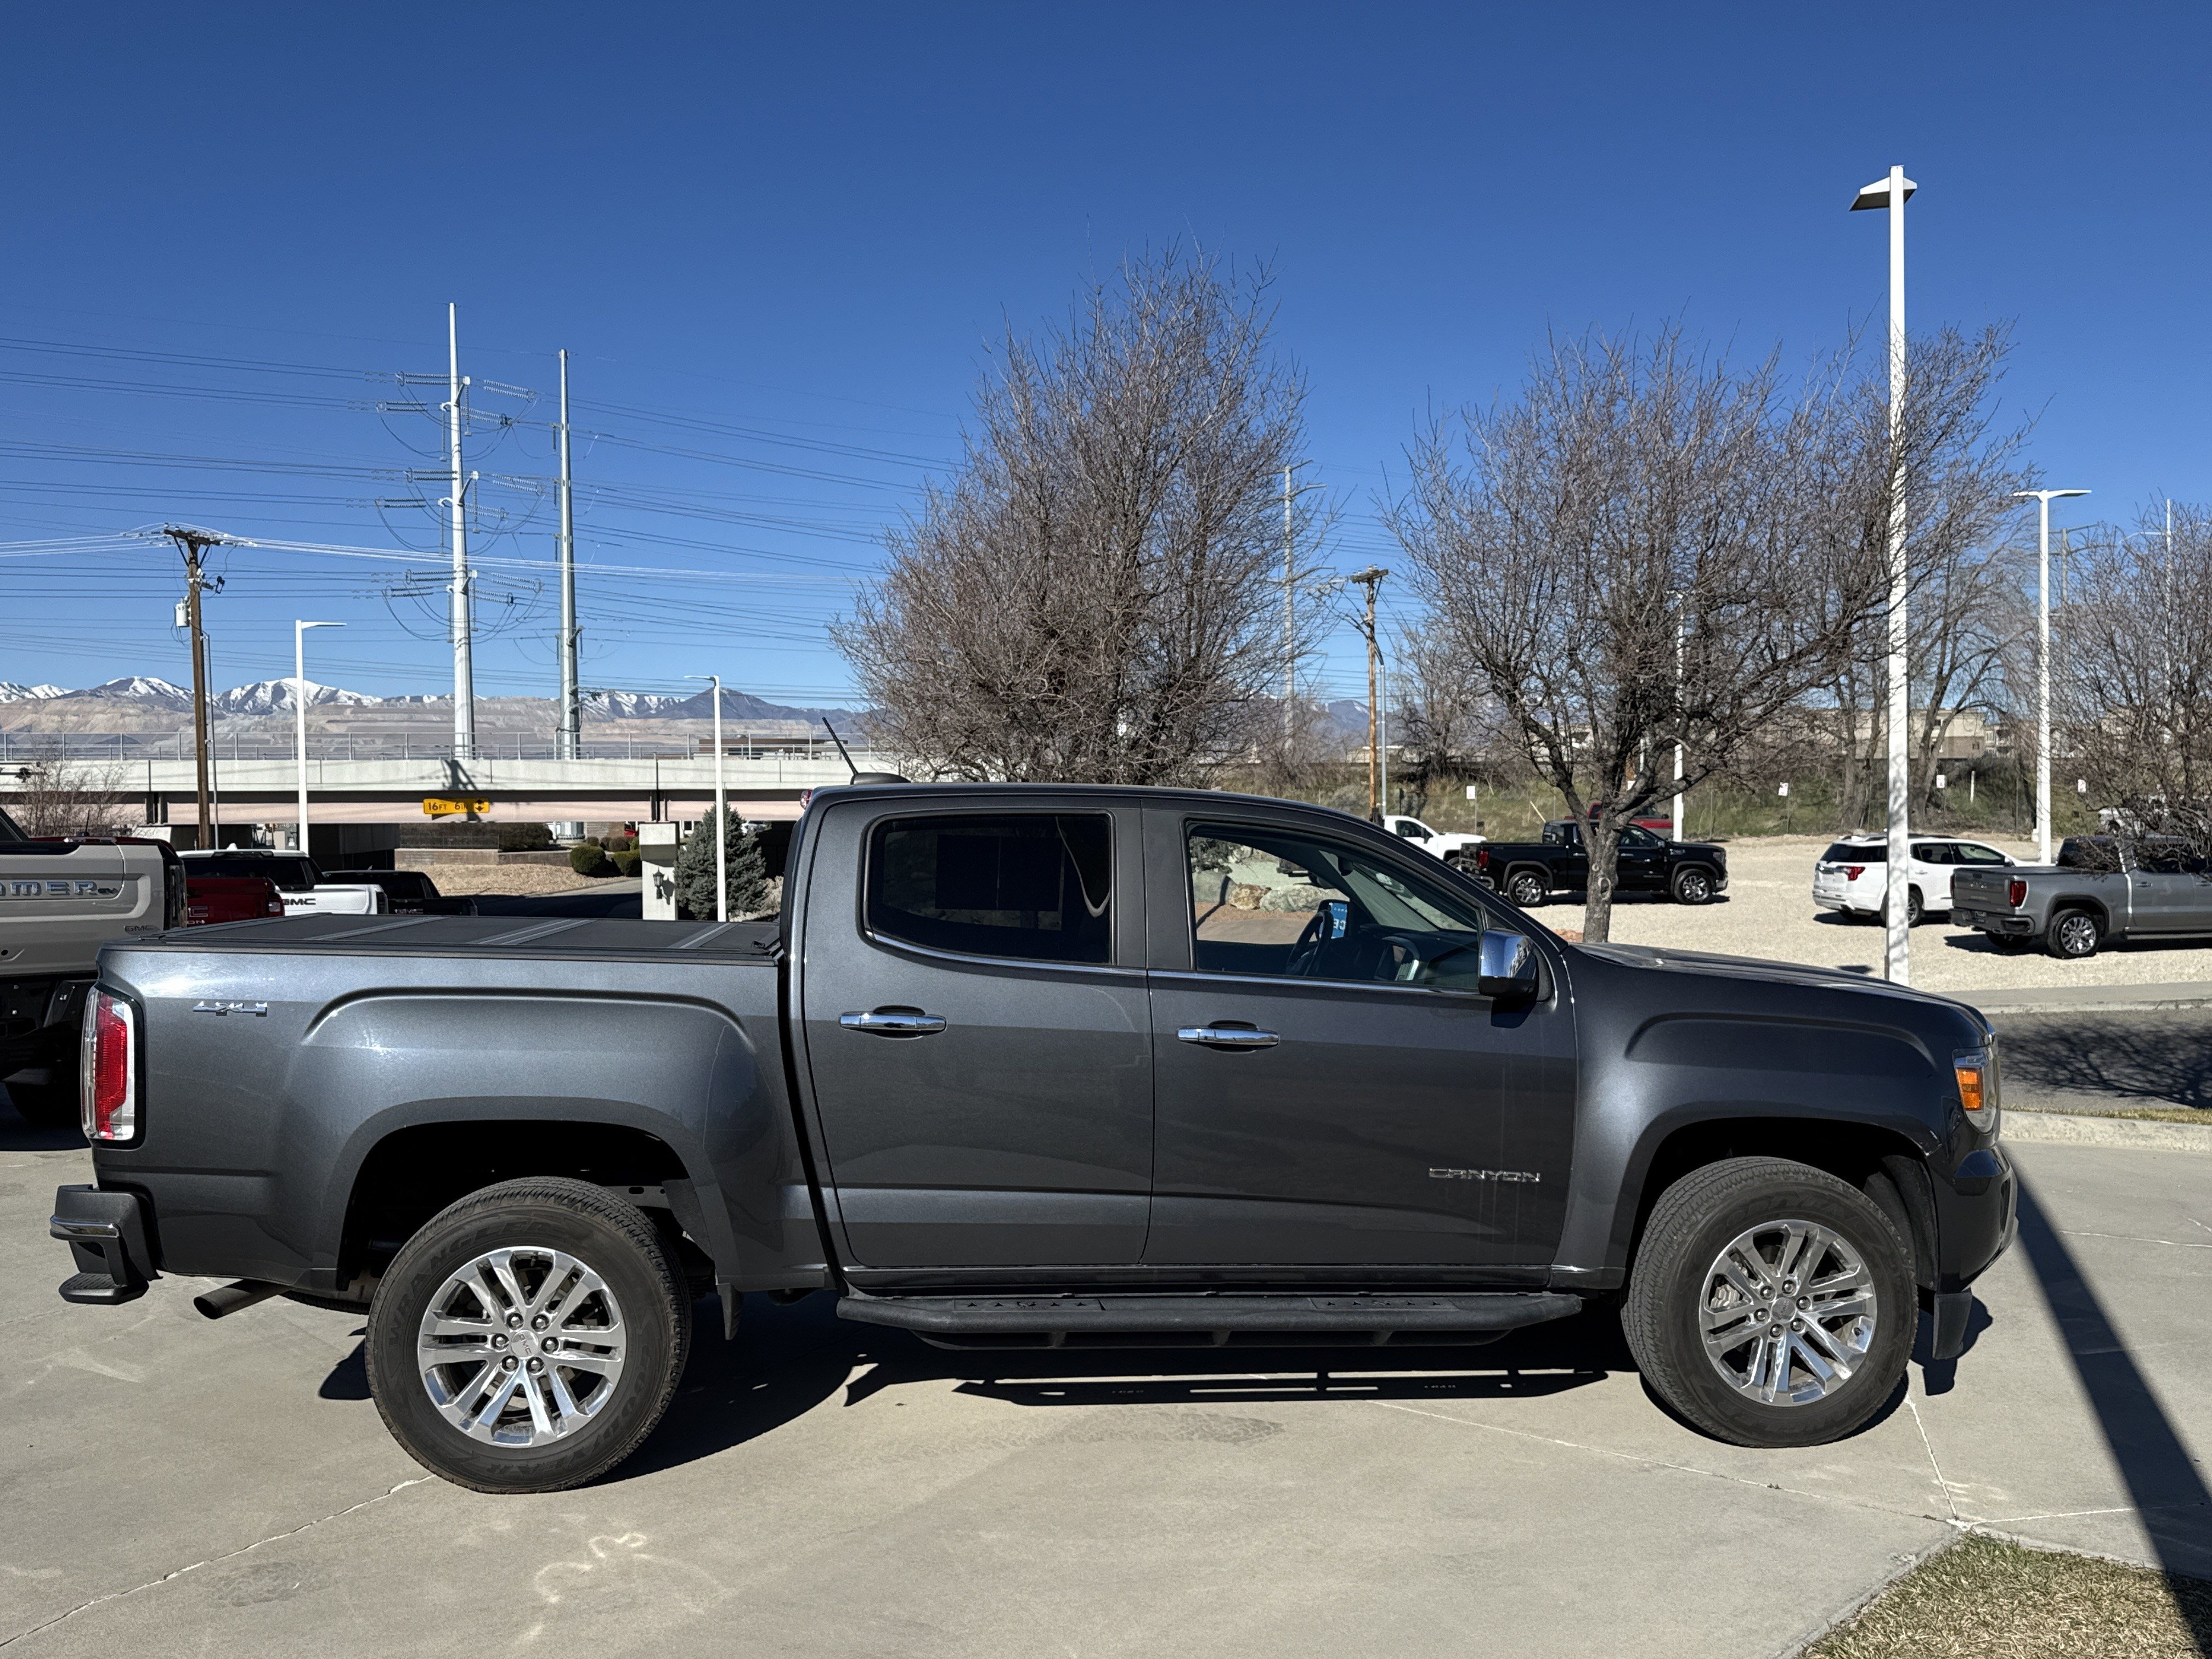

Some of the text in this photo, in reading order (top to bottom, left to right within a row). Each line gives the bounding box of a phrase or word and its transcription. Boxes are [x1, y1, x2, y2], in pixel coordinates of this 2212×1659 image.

[0, 881, 97, 896] MER
[1429, 1168, 1540, 1182] CANYON
[518, 1334, 532, 1355] GMC
